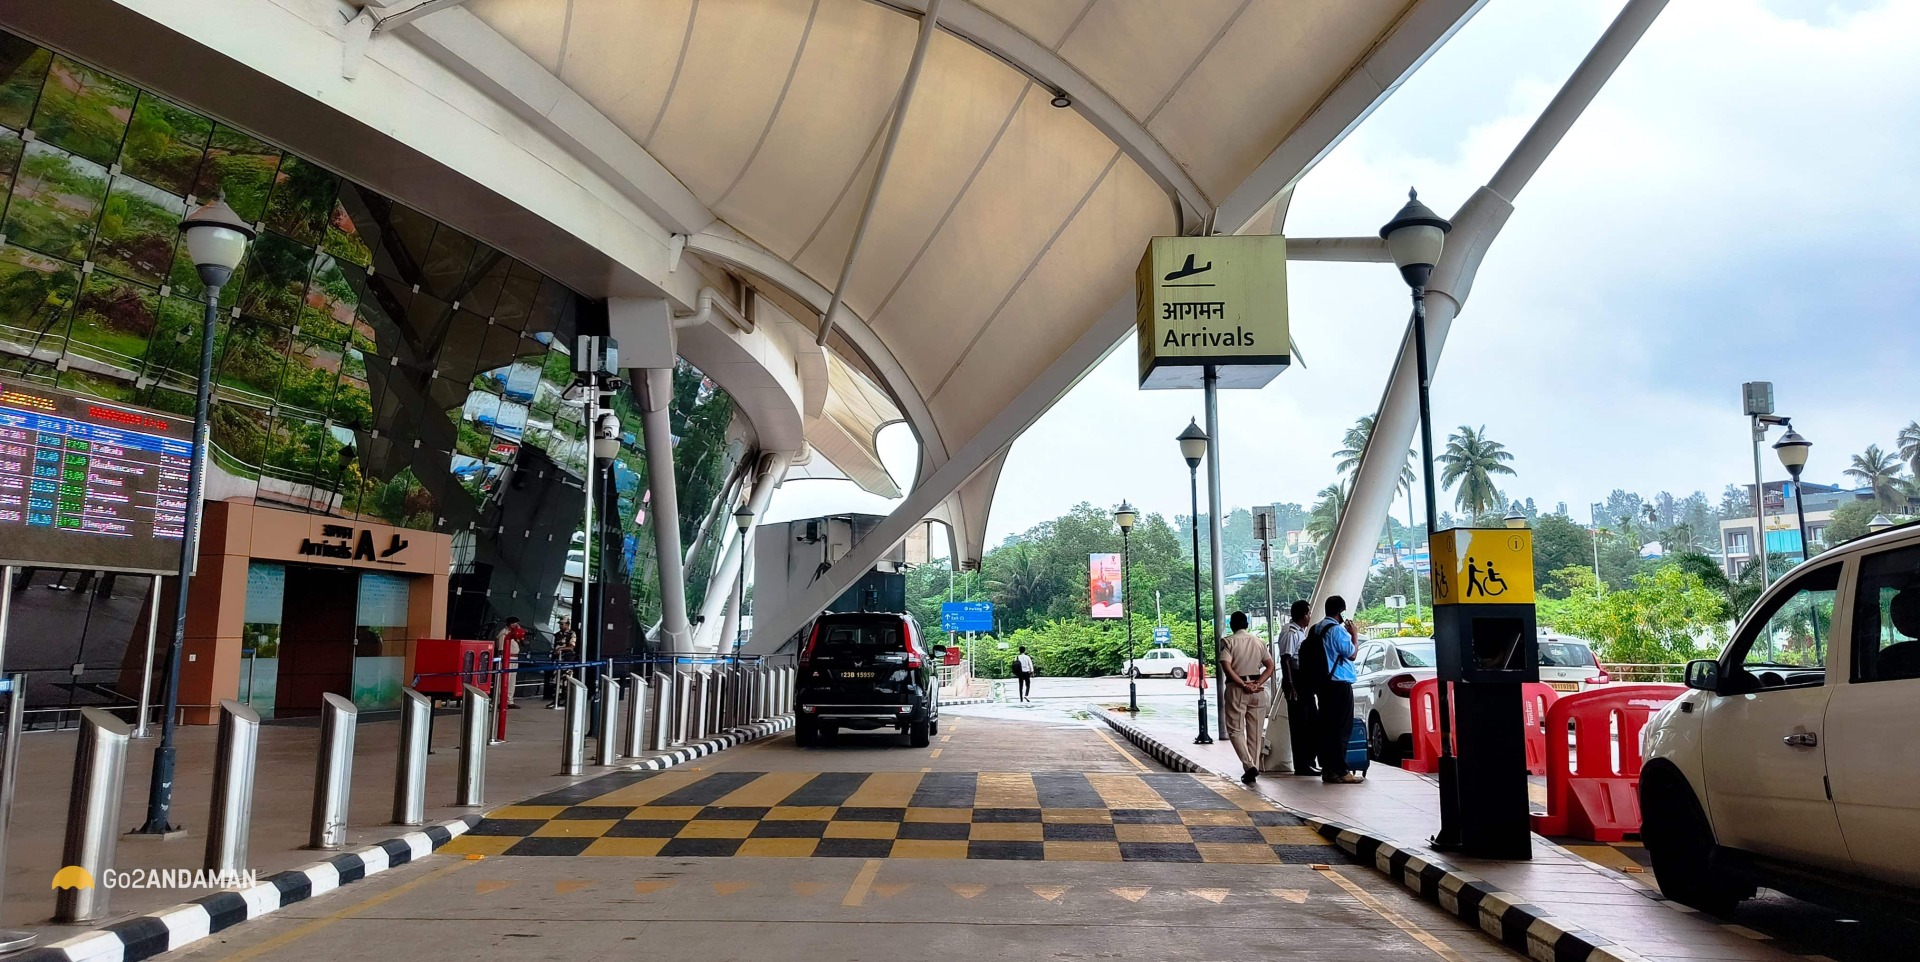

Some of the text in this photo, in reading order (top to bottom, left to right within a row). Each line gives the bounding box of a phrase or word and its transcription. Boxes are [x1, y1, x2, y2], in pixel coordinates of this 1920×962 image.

[1162, 302, 1225, 320] आगमन
[1163, 326, 1255, 347] Arrivals
[354, 529, 377, 562] A
[1526, 700, 1535, 727] frontier
